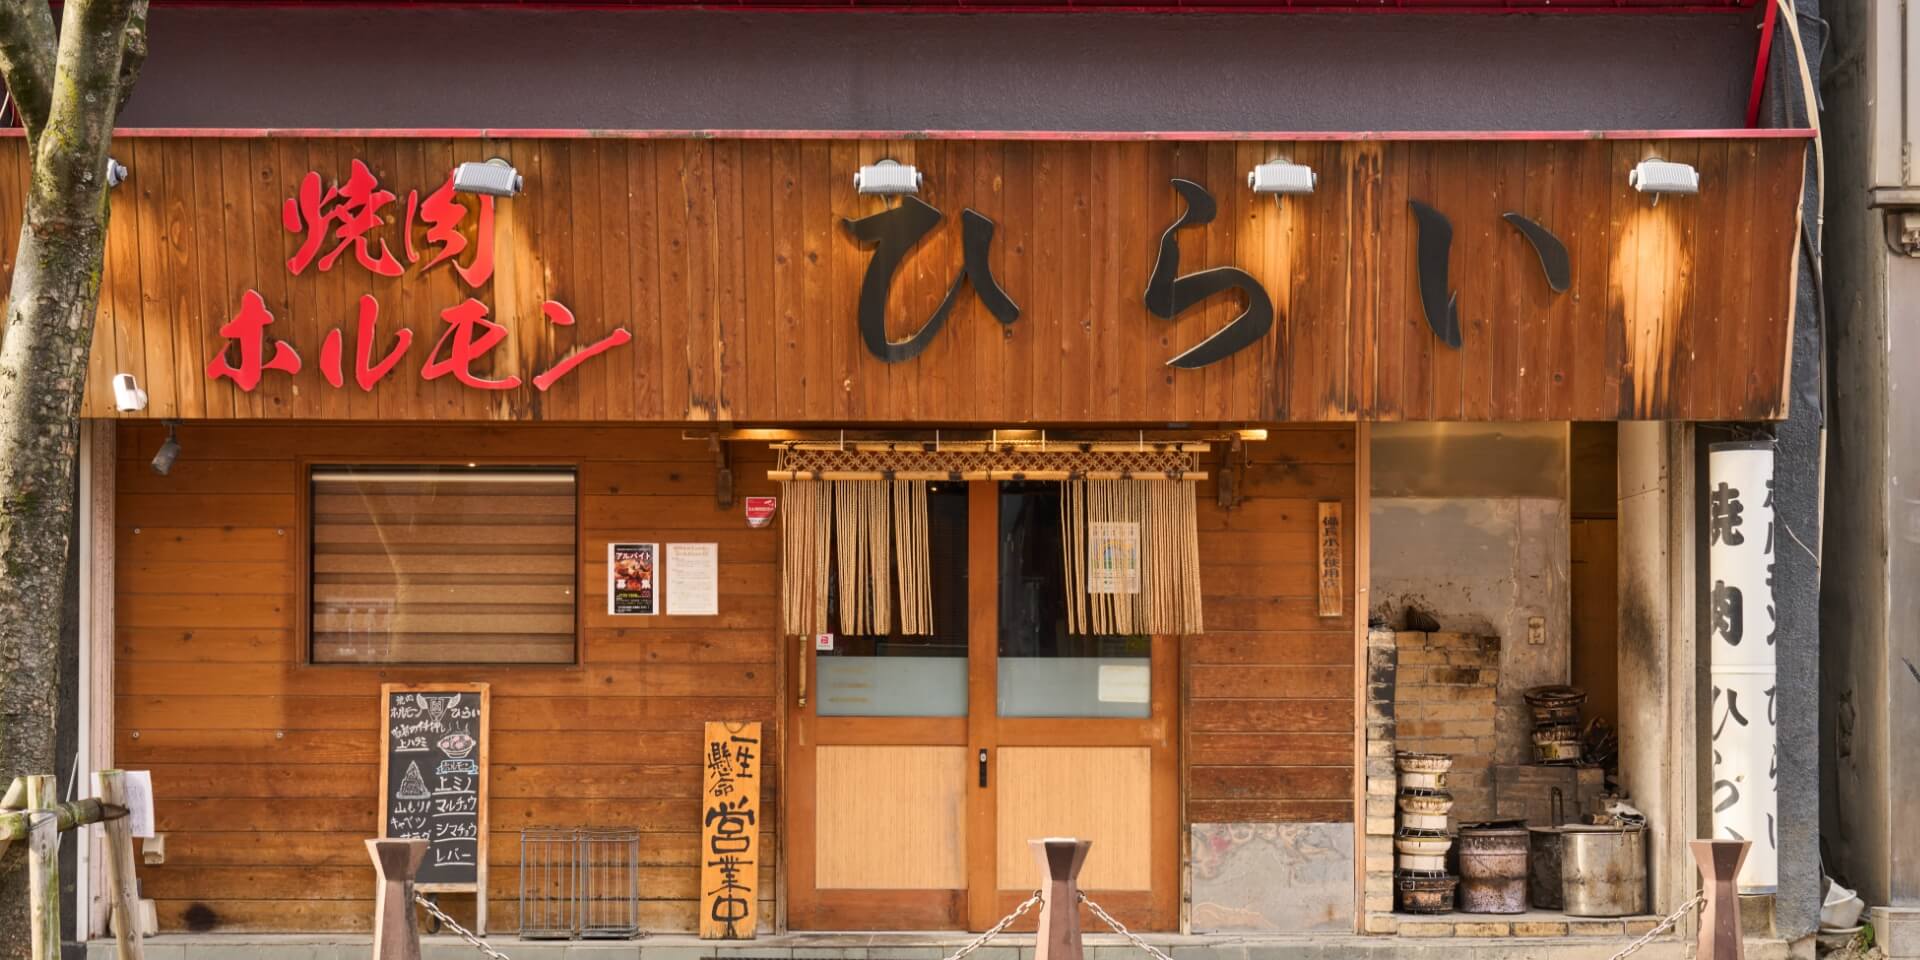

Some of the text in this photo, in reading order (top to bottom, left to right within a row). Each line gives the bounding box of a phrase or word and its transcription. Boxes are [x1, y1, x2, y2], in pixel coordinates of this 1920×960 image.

[283, 158, 497, 289] 焼肉
[842, 178, 1571, 370] ひらい
[207, 288, 632, 392] ホルモン
[615, 552, 651, 560] アルバイト
[390, 706, 423, 719] ホルモン
[450, 707, 480, 719] ひらい
[396, 736, 428, 749] 上ハラミ
[434, 776, 472, 792] 上ミノ
[435, 795, 478, 813] マルチョウ
[390, 816, 427, 831] キャベツ
[435, 822, 478, 837] シマチョウ
[435, 847, 472, 862] レバー
[704, 795, 755, 937] 営業中
